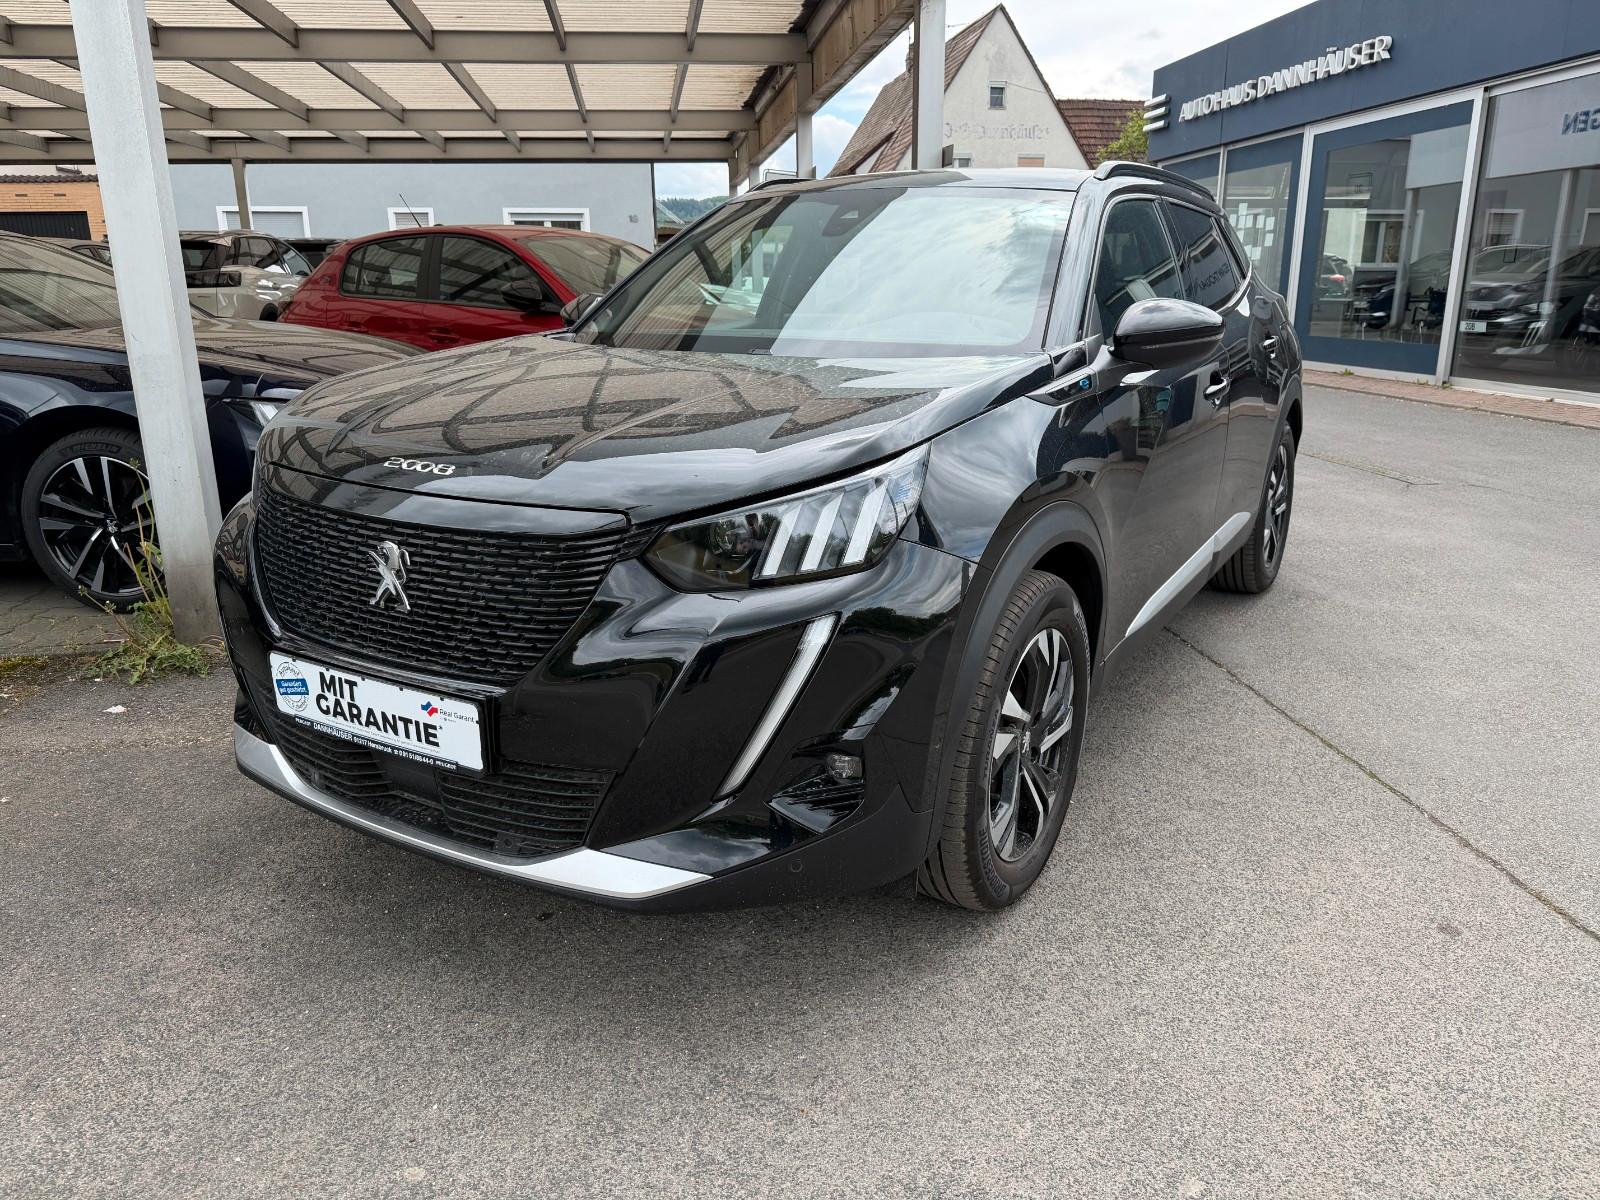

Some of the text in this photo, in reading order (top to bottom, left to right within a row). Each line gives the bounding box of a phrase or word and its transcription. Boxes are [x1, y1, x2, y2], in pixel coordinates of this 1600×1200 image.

[1178, 35, 1393, 123] AUTOHAUS DANNHÄUSER
[383, 456, 456, 475] 2008
[318, 671, 358, 702] MIT
[439, 708, 453, 717] Real
[453, 712, 475, 723] Garant
